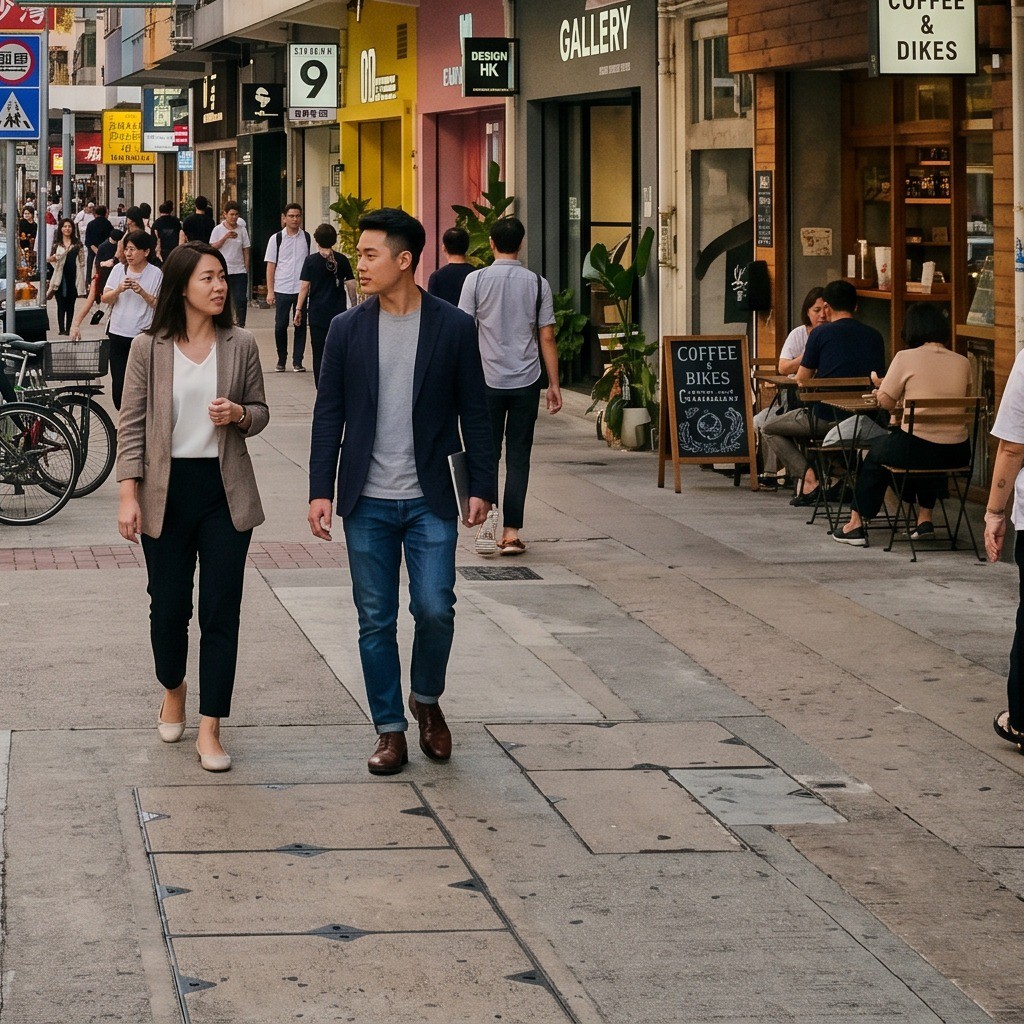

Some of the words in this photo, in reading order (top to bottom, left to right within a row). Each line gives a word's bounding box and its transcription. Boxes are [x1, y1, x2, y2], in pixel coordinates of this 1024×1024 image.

[559, 4, 631, 62] GALLERY
[920, 14, 934, 34] &
[471, 51, 508, 61] DESIGN
[897, 41, 957, 60] DIKES
[299, 59, 328, 99] 9
[480, 63, 499, 77] HK
[677, 345, 737, 362] COFFEE
[685, 371, 730, 385] BIKES
